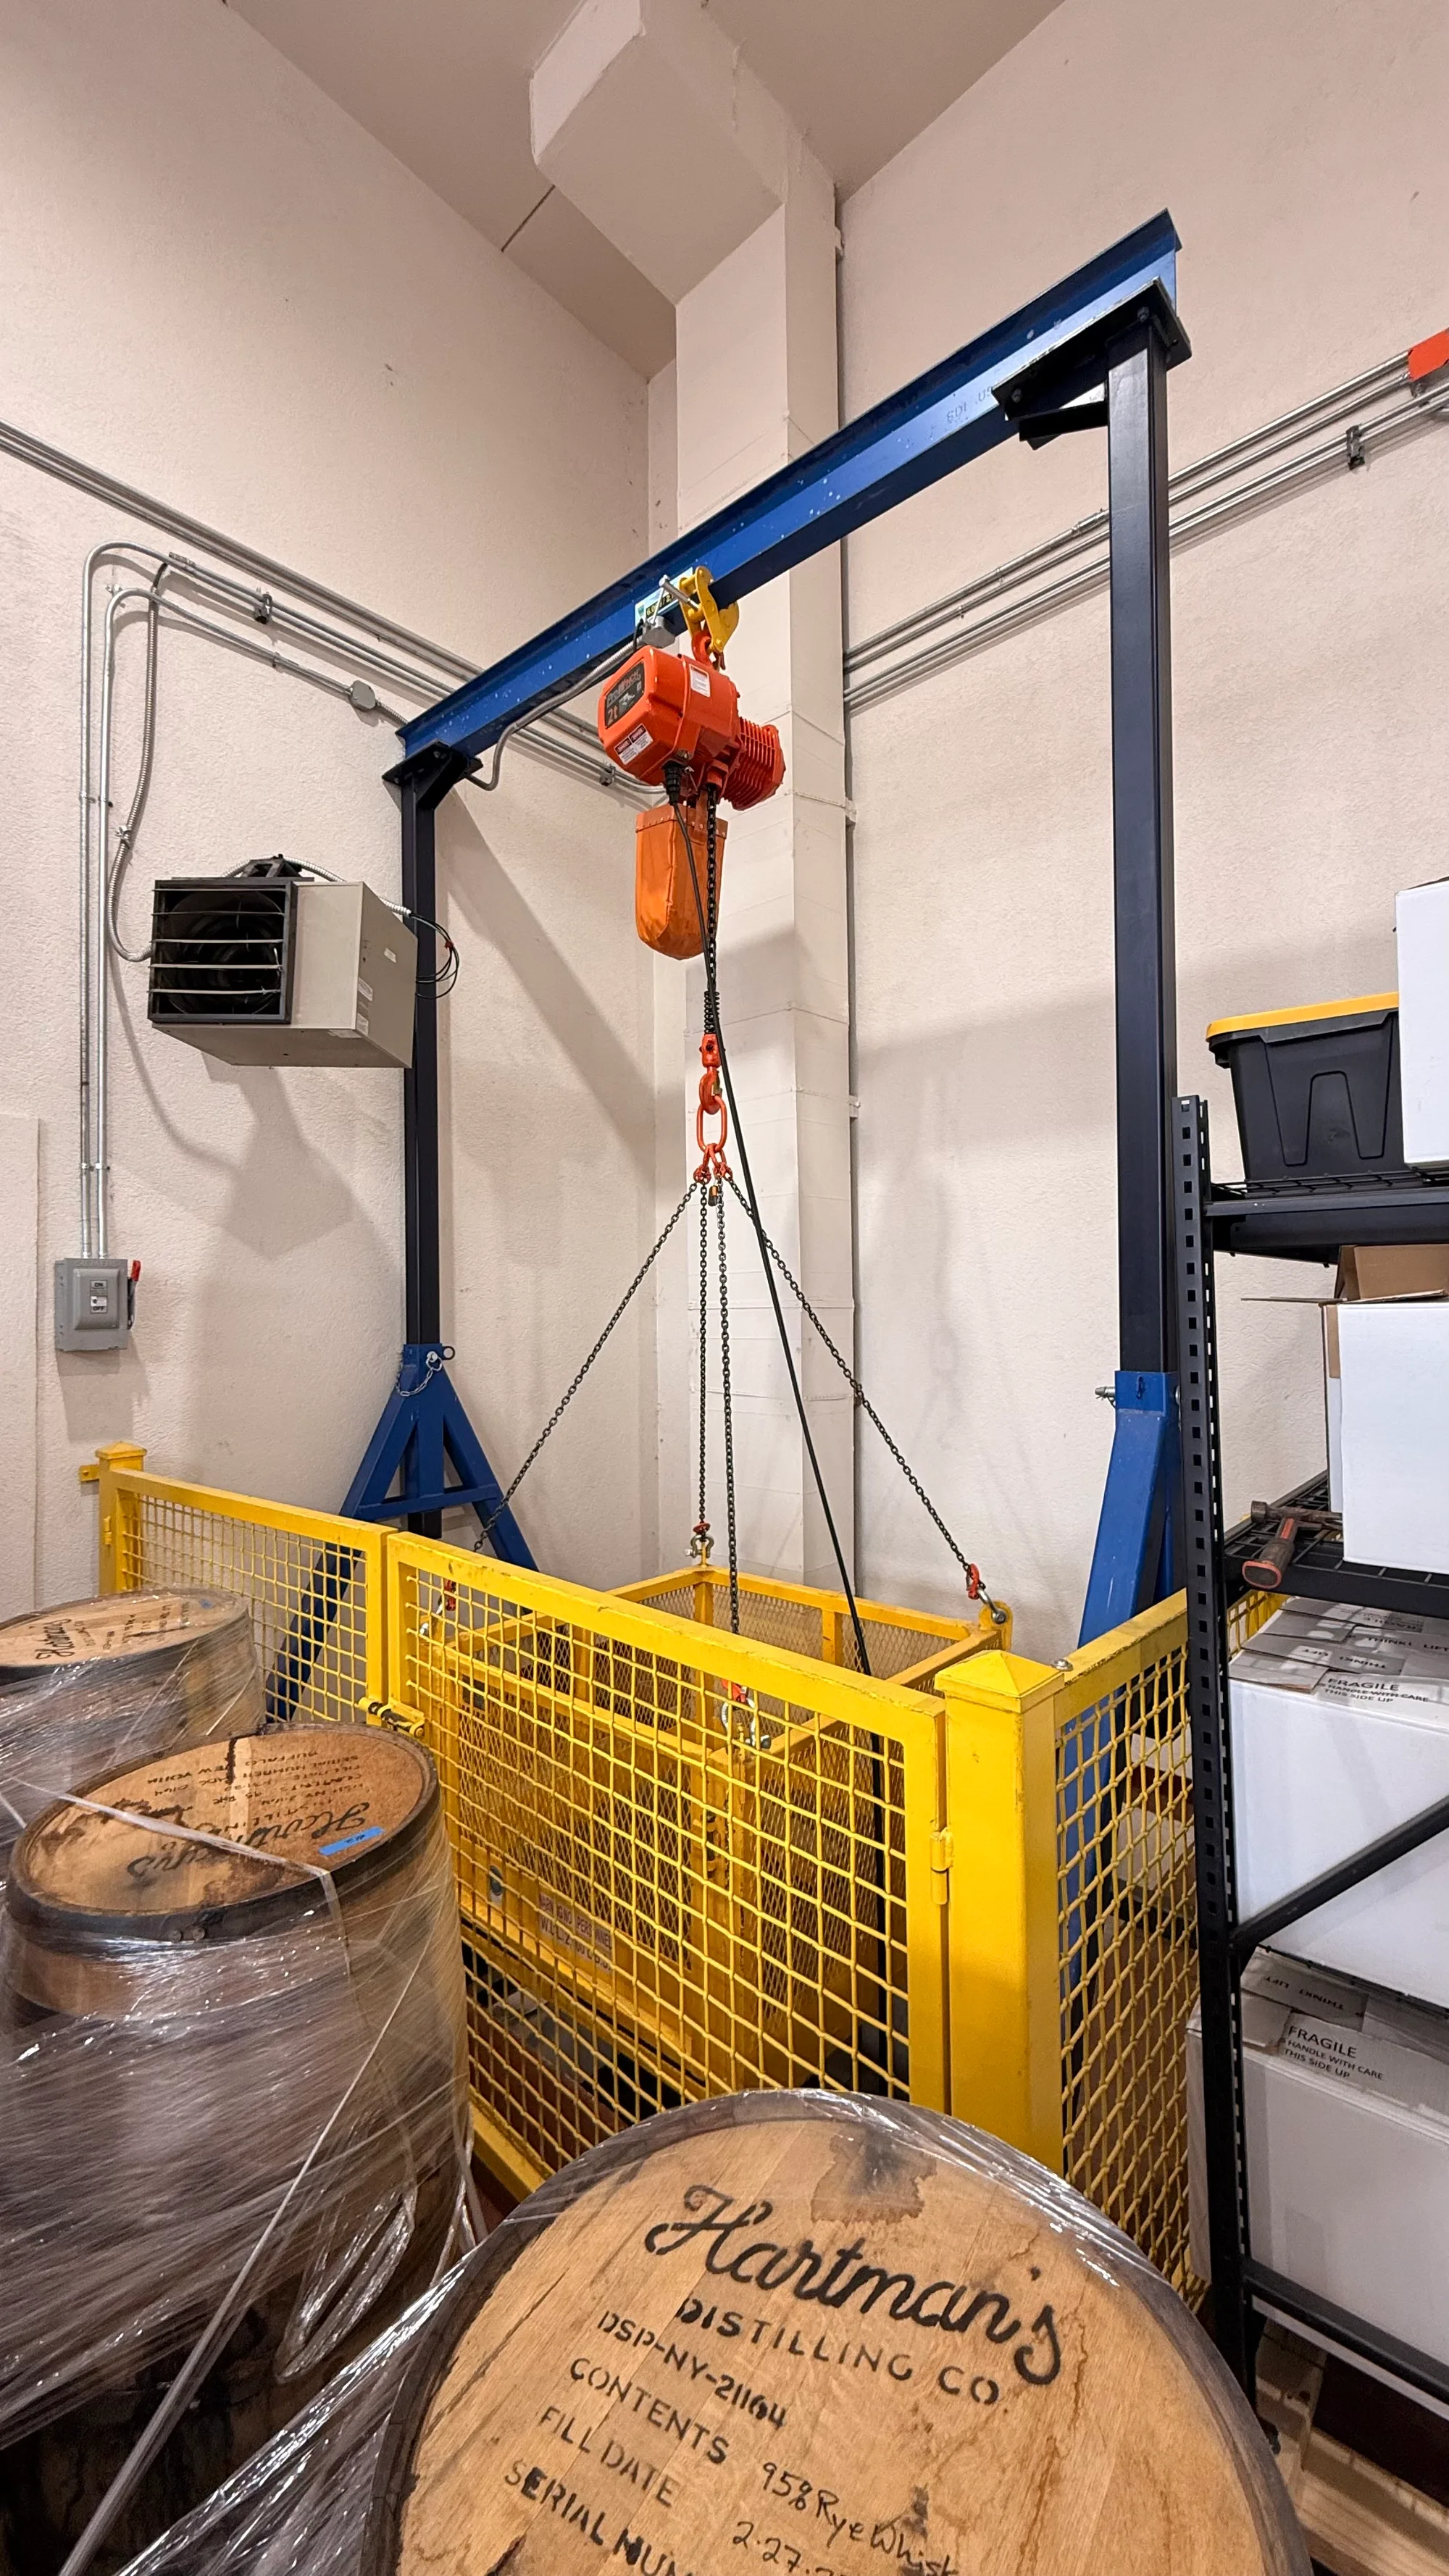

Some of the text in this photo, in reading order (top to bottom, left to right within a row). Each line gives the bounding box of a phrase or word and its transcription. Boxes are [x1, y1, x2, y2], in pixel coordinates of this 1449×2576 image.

[1327, 1678, 1400, 1691] FRAGILE
[1327, 1684, 1372, 1695] HANDLE
[1399, 1693, 1429, 1702] CARE
[1285, 2049, 1350, 2078] THIS SIDE UP
[1288, 2025, 1357, 2059] FRAGILE
[1288, 2039, 1384, 2080] HANDLE WITH CARE
[644, 2184, 1061, 2385] Hartman's
[597, 2310, 788, 2430] DSP-NY-21164
[677, 2297, 914, 2381] DISTILLING
[569, 2357, 730, 2464] CONTENTS
[538, 2405, 681, 2508] FILL DATE
[504, 2458, 606, 2546] SERIAL
[816, 2489, 864, 2548] Rye
